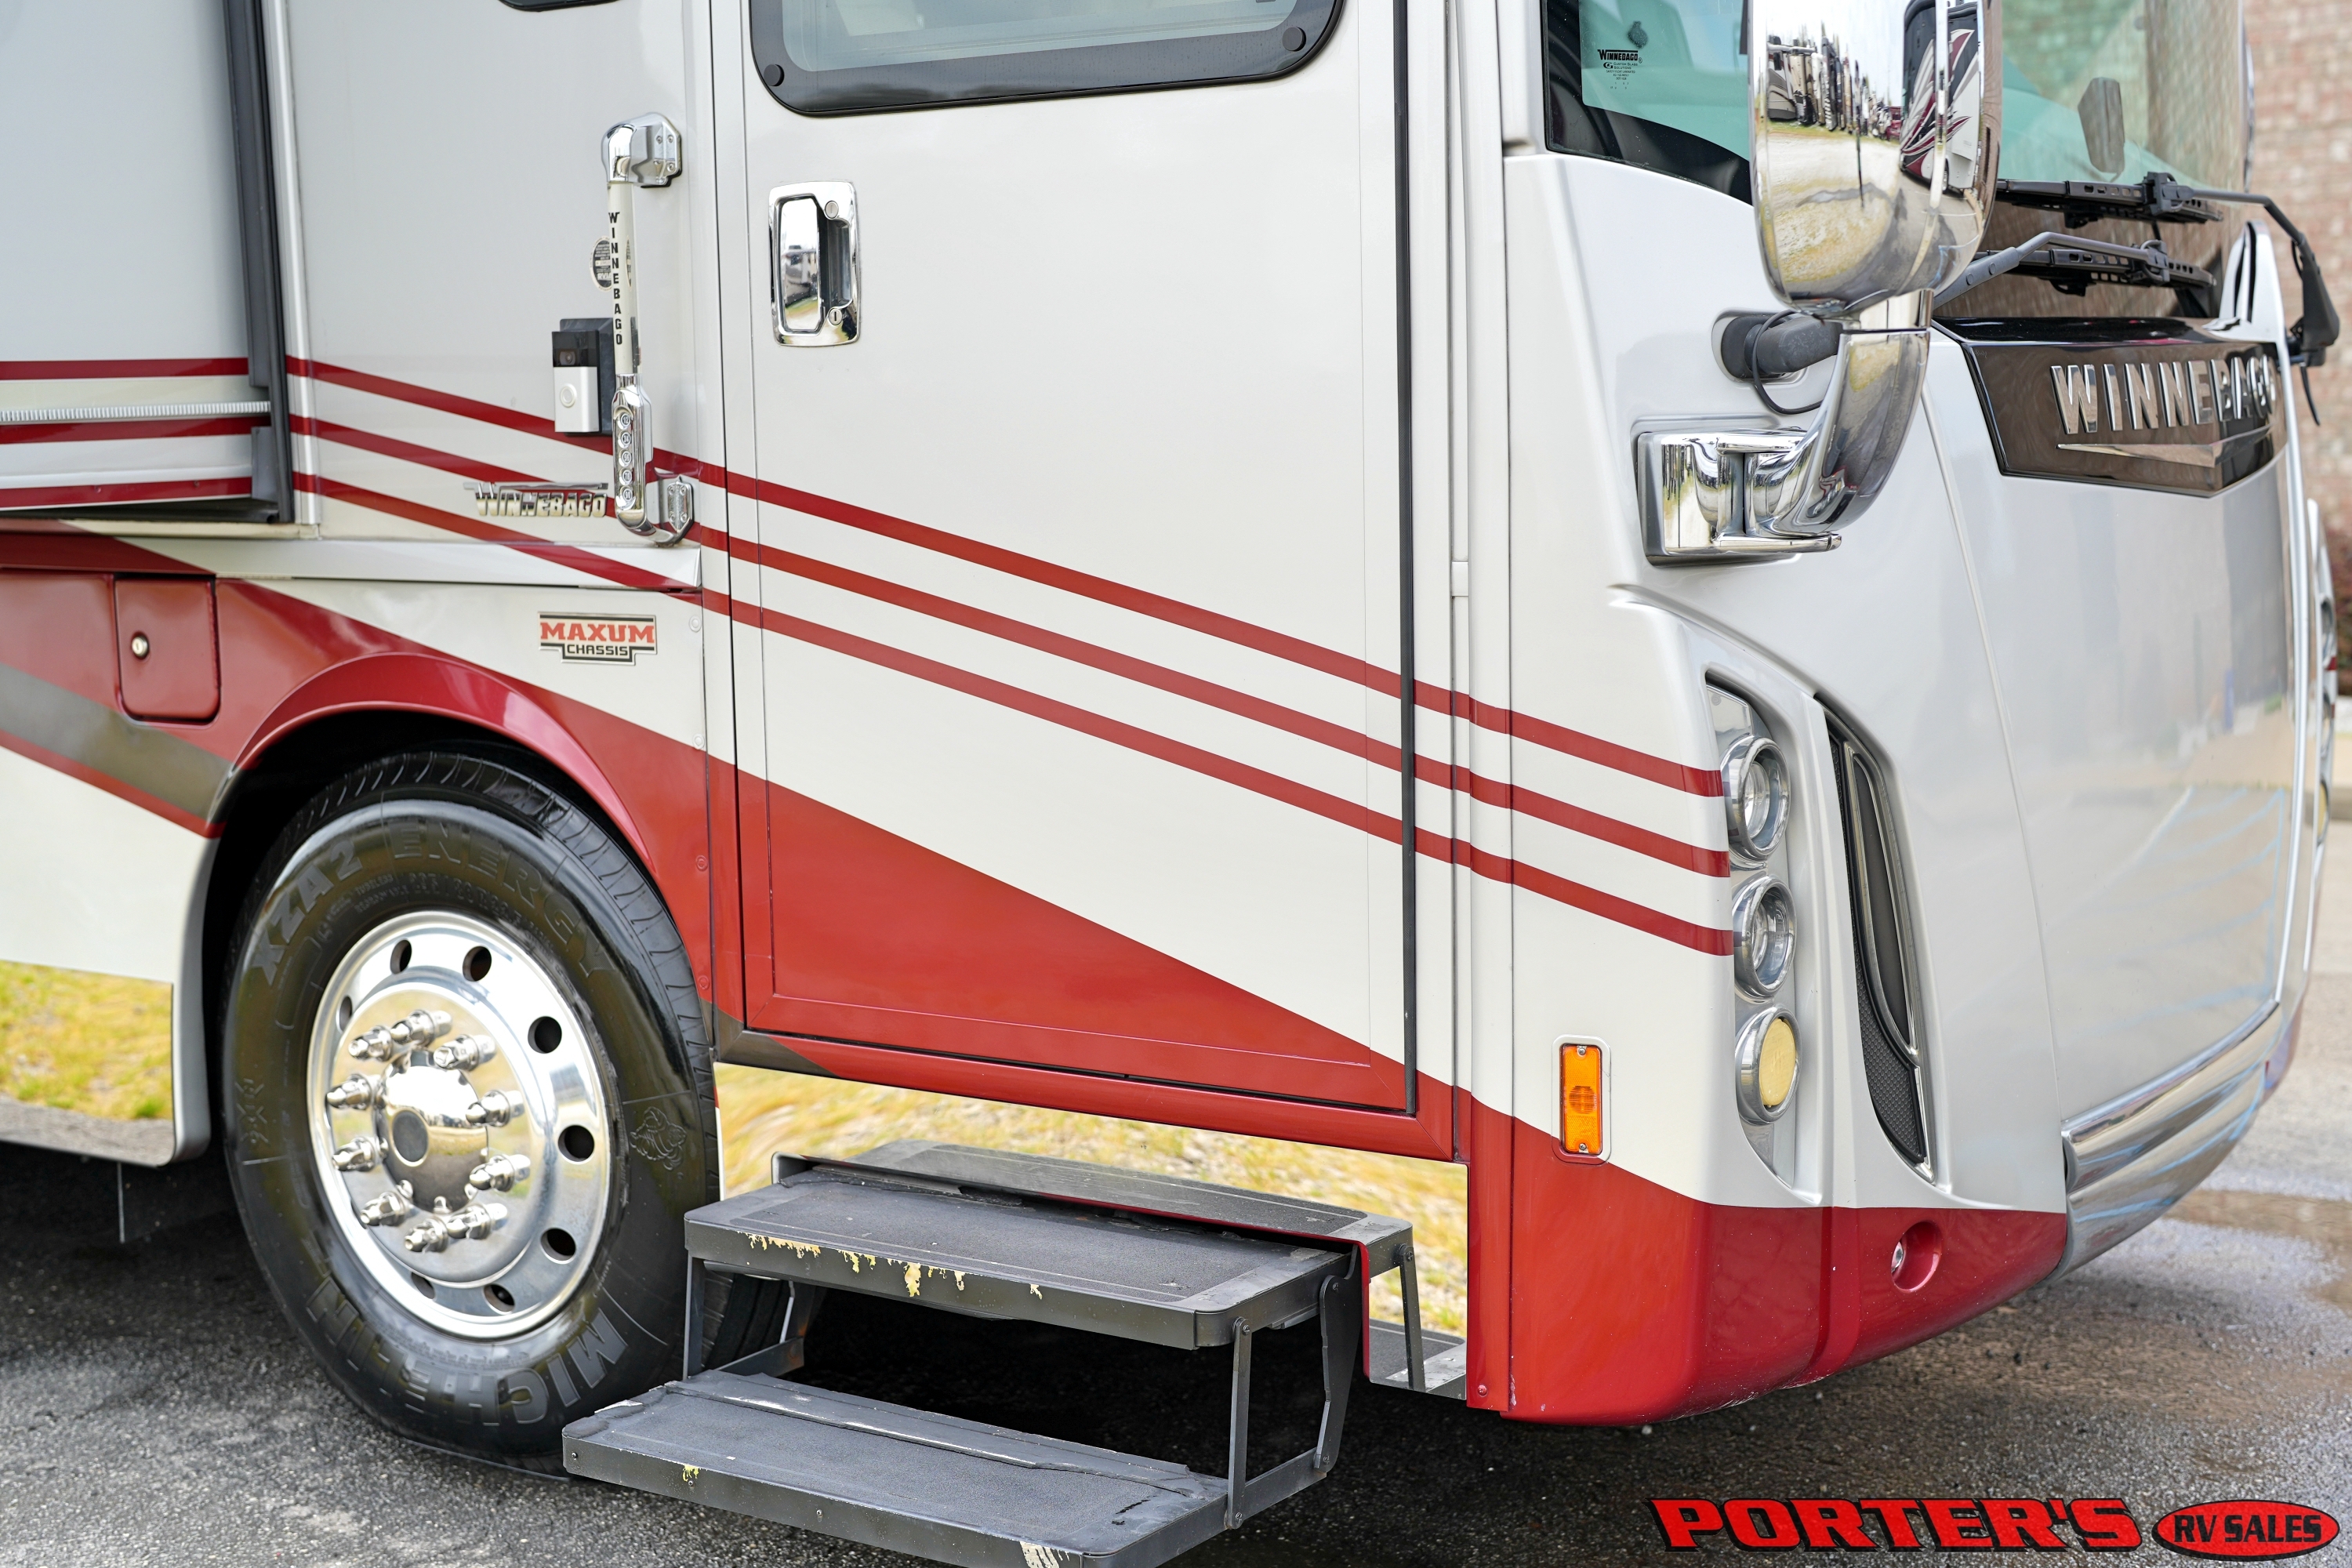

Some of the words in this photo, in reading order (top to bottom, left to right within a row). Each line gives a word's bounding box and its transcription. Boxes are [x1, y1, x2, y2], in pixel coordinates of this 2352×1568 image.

[1597, 49, 1639, 61] WINNEBAGO
[608, 212, 622, 345] WINNEBAGO
[2049, 354, 2277, 434] WINNEBAGO
[463, 482, 608, 517] WINNEBAGO
[540, 622, 655, 643] MAXUM
[567, 644, 628, 655] CHASSIS
[389, 821, 616, 978] ENERGY
